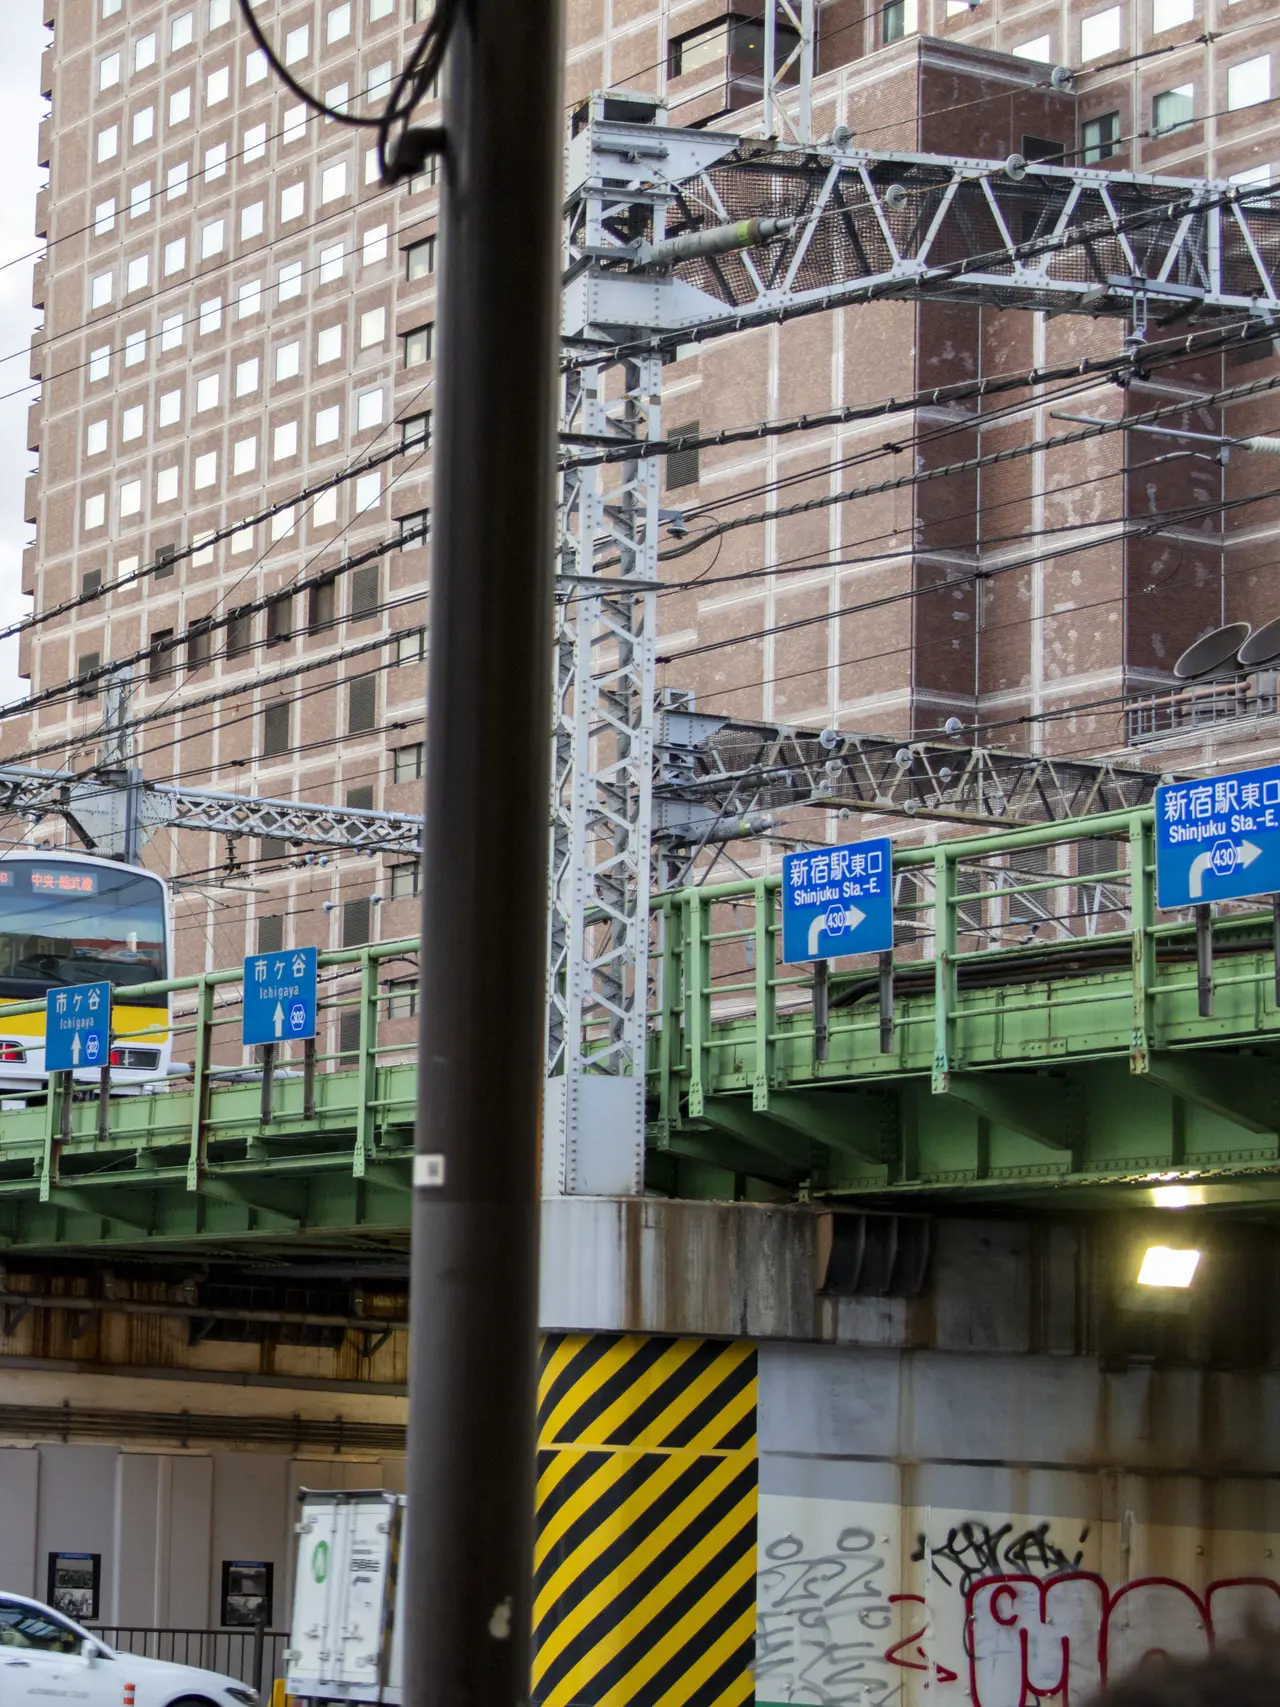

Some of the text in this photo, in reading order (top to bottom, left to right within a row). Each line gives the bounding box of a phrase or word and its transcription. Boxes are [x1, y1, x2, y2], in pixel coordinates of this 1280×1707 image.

[1164, 780, 1280, 822] 新宿駅東口
[1169, 820, 1226, 843] Shinjuku
[1213, 847, 1234, 867] 430
[790, 850, 882, 887] 新宿駅東口
[794, 886, 839, 905] Shinjuku
[827, 912, 844, 928] 430
[260, 985, 299, 1000] Ichigaya
[60, 1016, 95, 1030] Ichigaya
[292, 1011, 304, 1024] 302
